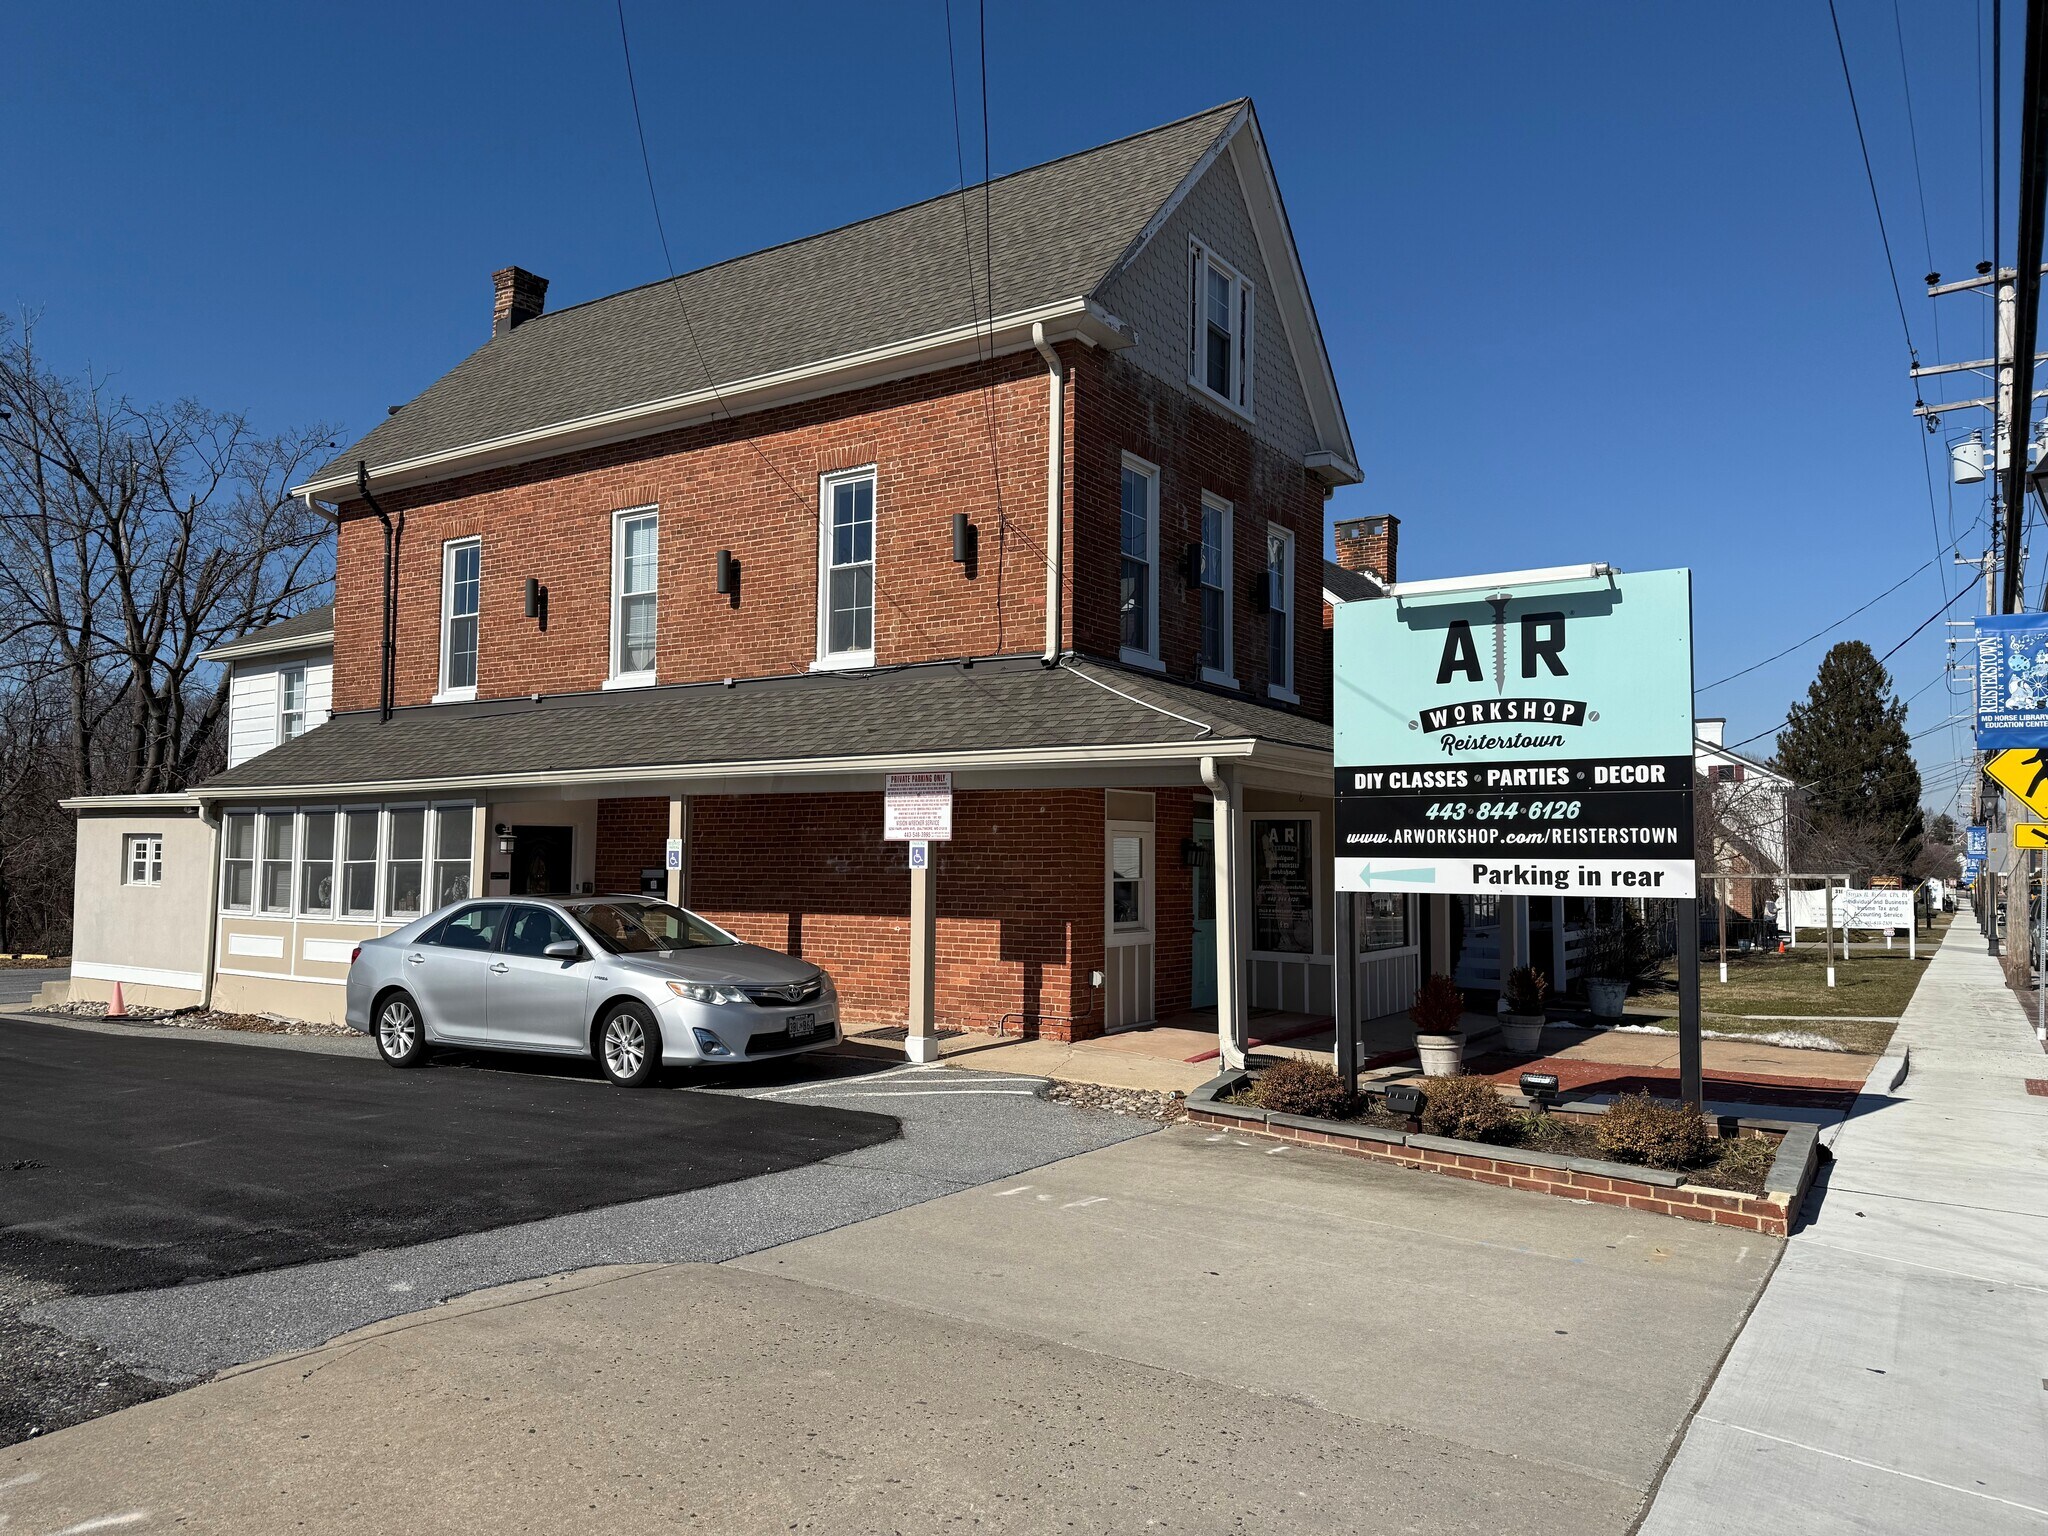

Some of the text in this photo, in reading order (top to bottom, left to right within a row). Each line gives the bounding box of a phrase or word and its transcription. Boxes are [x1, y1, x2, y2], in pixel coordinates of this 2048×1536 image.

[1978, 637, 1998, 713] REISTERSTOWN
[1429, 700, 1576, 729] WORKSHOP
[1440, 732, 1566, 756] Reisterstown
[1354, 764, 1666, 790] DIY CLASSES PARTIES DECOR
[1345, 827, 1679, 846] www.ARWORKSHOP.com/REISTERSTOWN
[1472, 864, 1666, 889] Parking in rear
